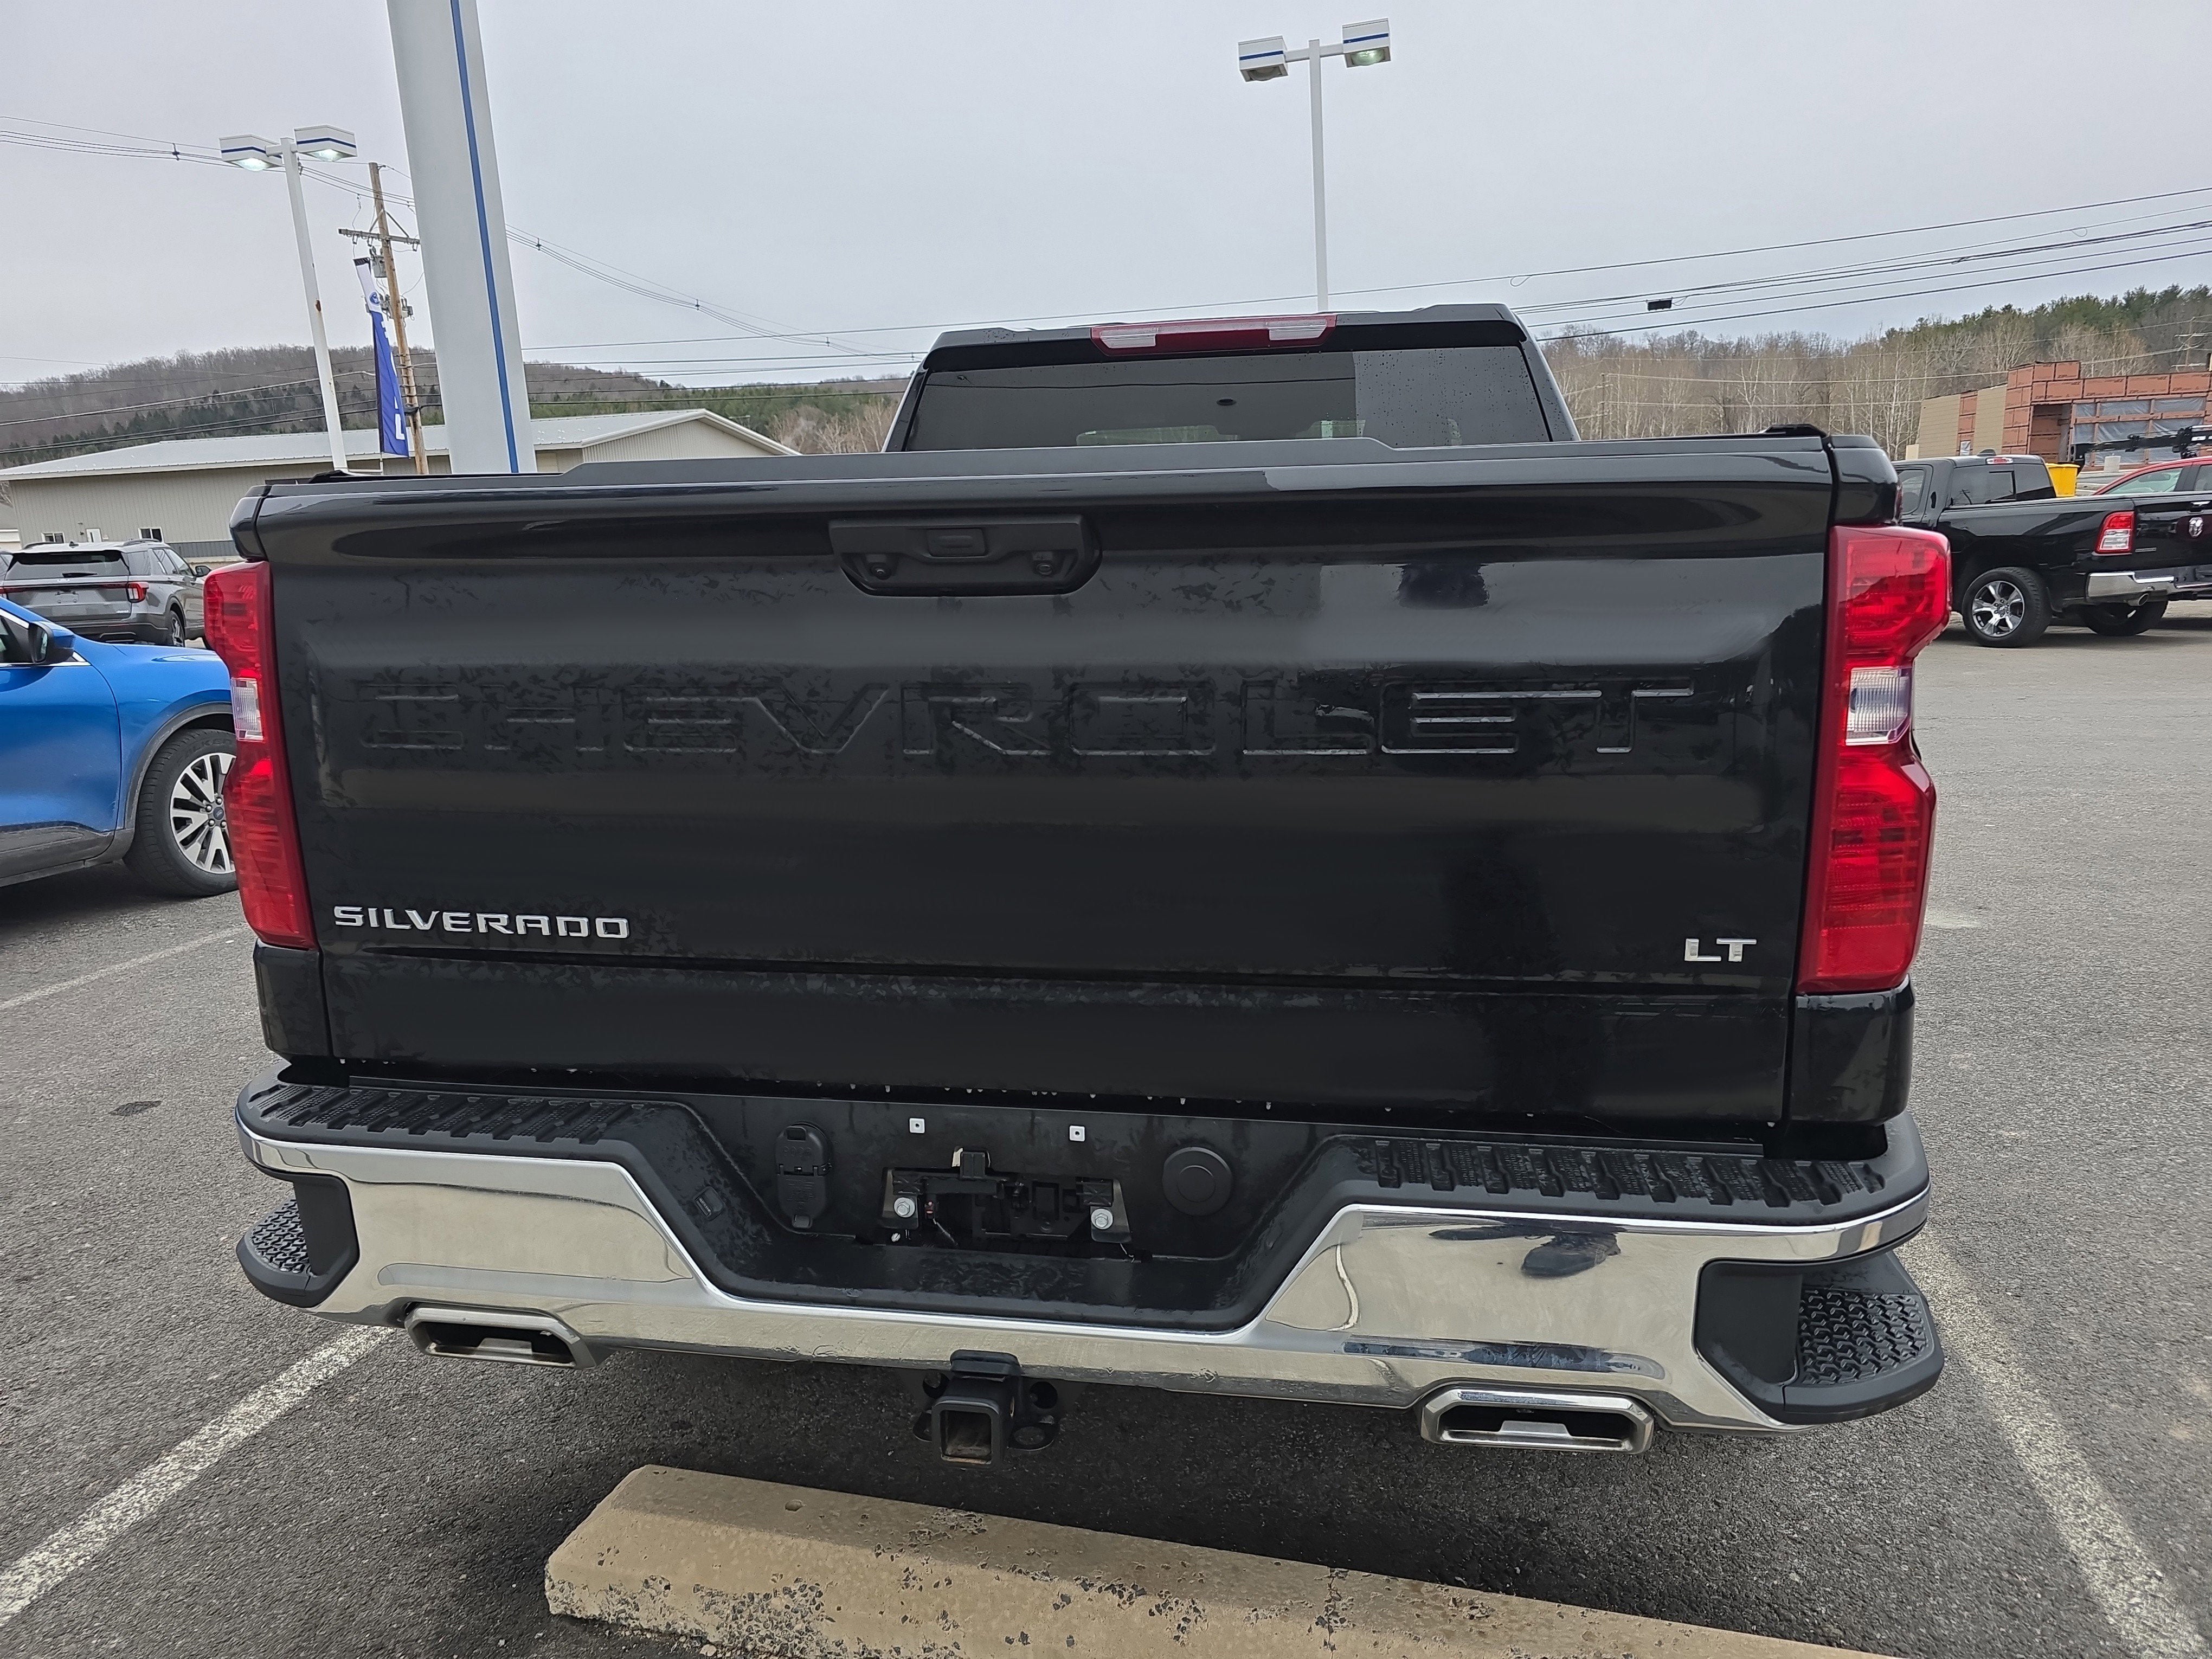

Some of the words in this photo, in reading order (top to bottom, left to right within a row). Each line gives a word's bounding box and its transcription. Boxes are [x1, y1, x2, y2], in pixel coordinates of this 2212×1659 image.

[359, 678, 1694, 755] CHEVROLET
[333, 906, 630, 938] SILVERADO
[1684, 938, 1757, 962] LT
